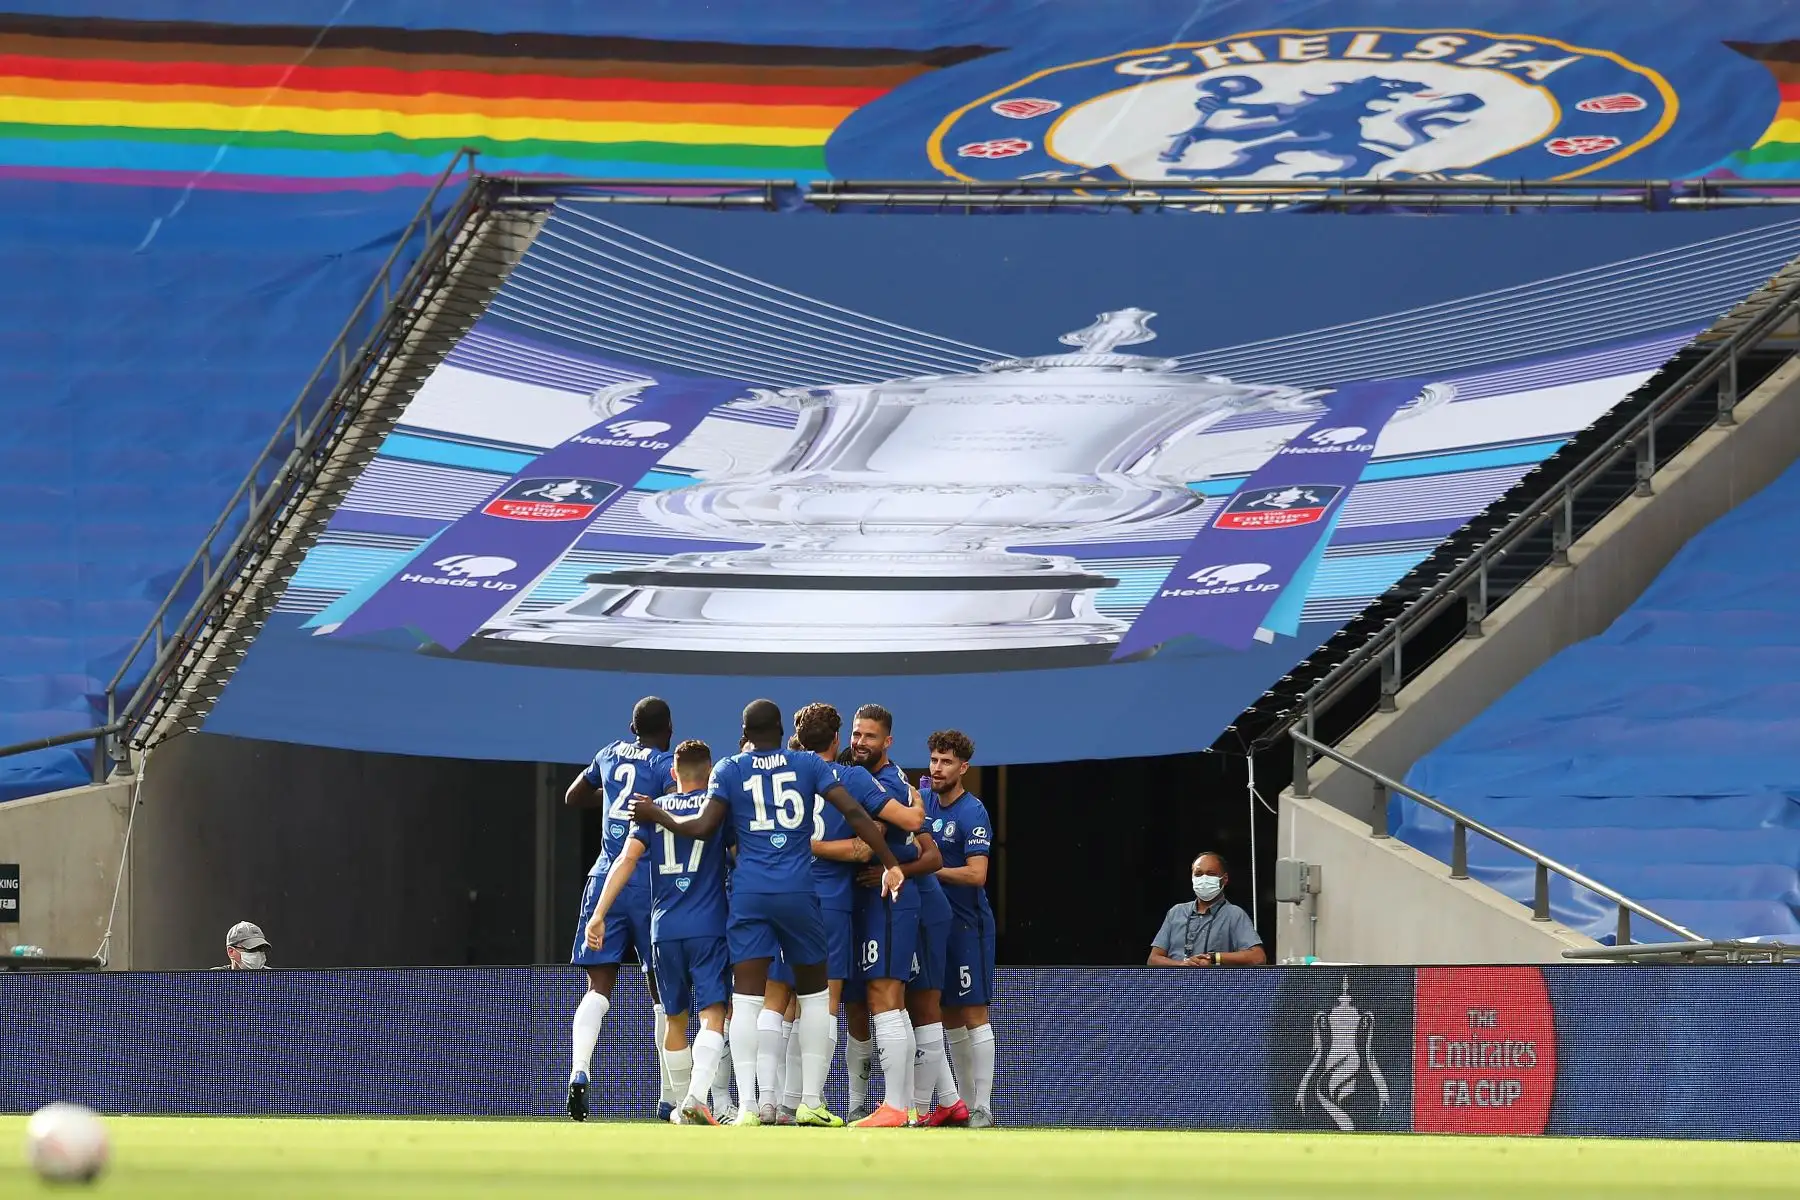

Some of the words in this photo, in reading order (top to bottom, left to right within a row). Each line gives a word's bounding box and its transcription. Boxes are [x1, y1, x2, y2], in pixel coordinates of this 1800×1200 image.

[1114, 33, 1584, 82] CHELSEA
[570, 435, 636, 448] Heads
[639, 439, 671, 452] Up
[1281, 444, 1342, 455] Heads
[1347, 443, 1374, 453] Up
[502, 504, 580, 515] Emirates
[400, 573, 478, 588] Heads
[482, 579, 518, 592] Up
[1161, 586, 1241, 597] Heads
[1244, 583, 1280, 593] Up
[752, 754, 787, 770] ZOUMA
[608, 763, 636, 820] 2
[742, 771, 805, 832] 15
[861, 939, 879, 965] 18
[959, 965, 972, 989] 5
[1466, 1009, 1498, 1028] THE
[1426, 1034, 1537, 1069] Emirates
[1442, 1080, 1473, 1106] FA
[1475, 1080, 1522, 1106] CUP
